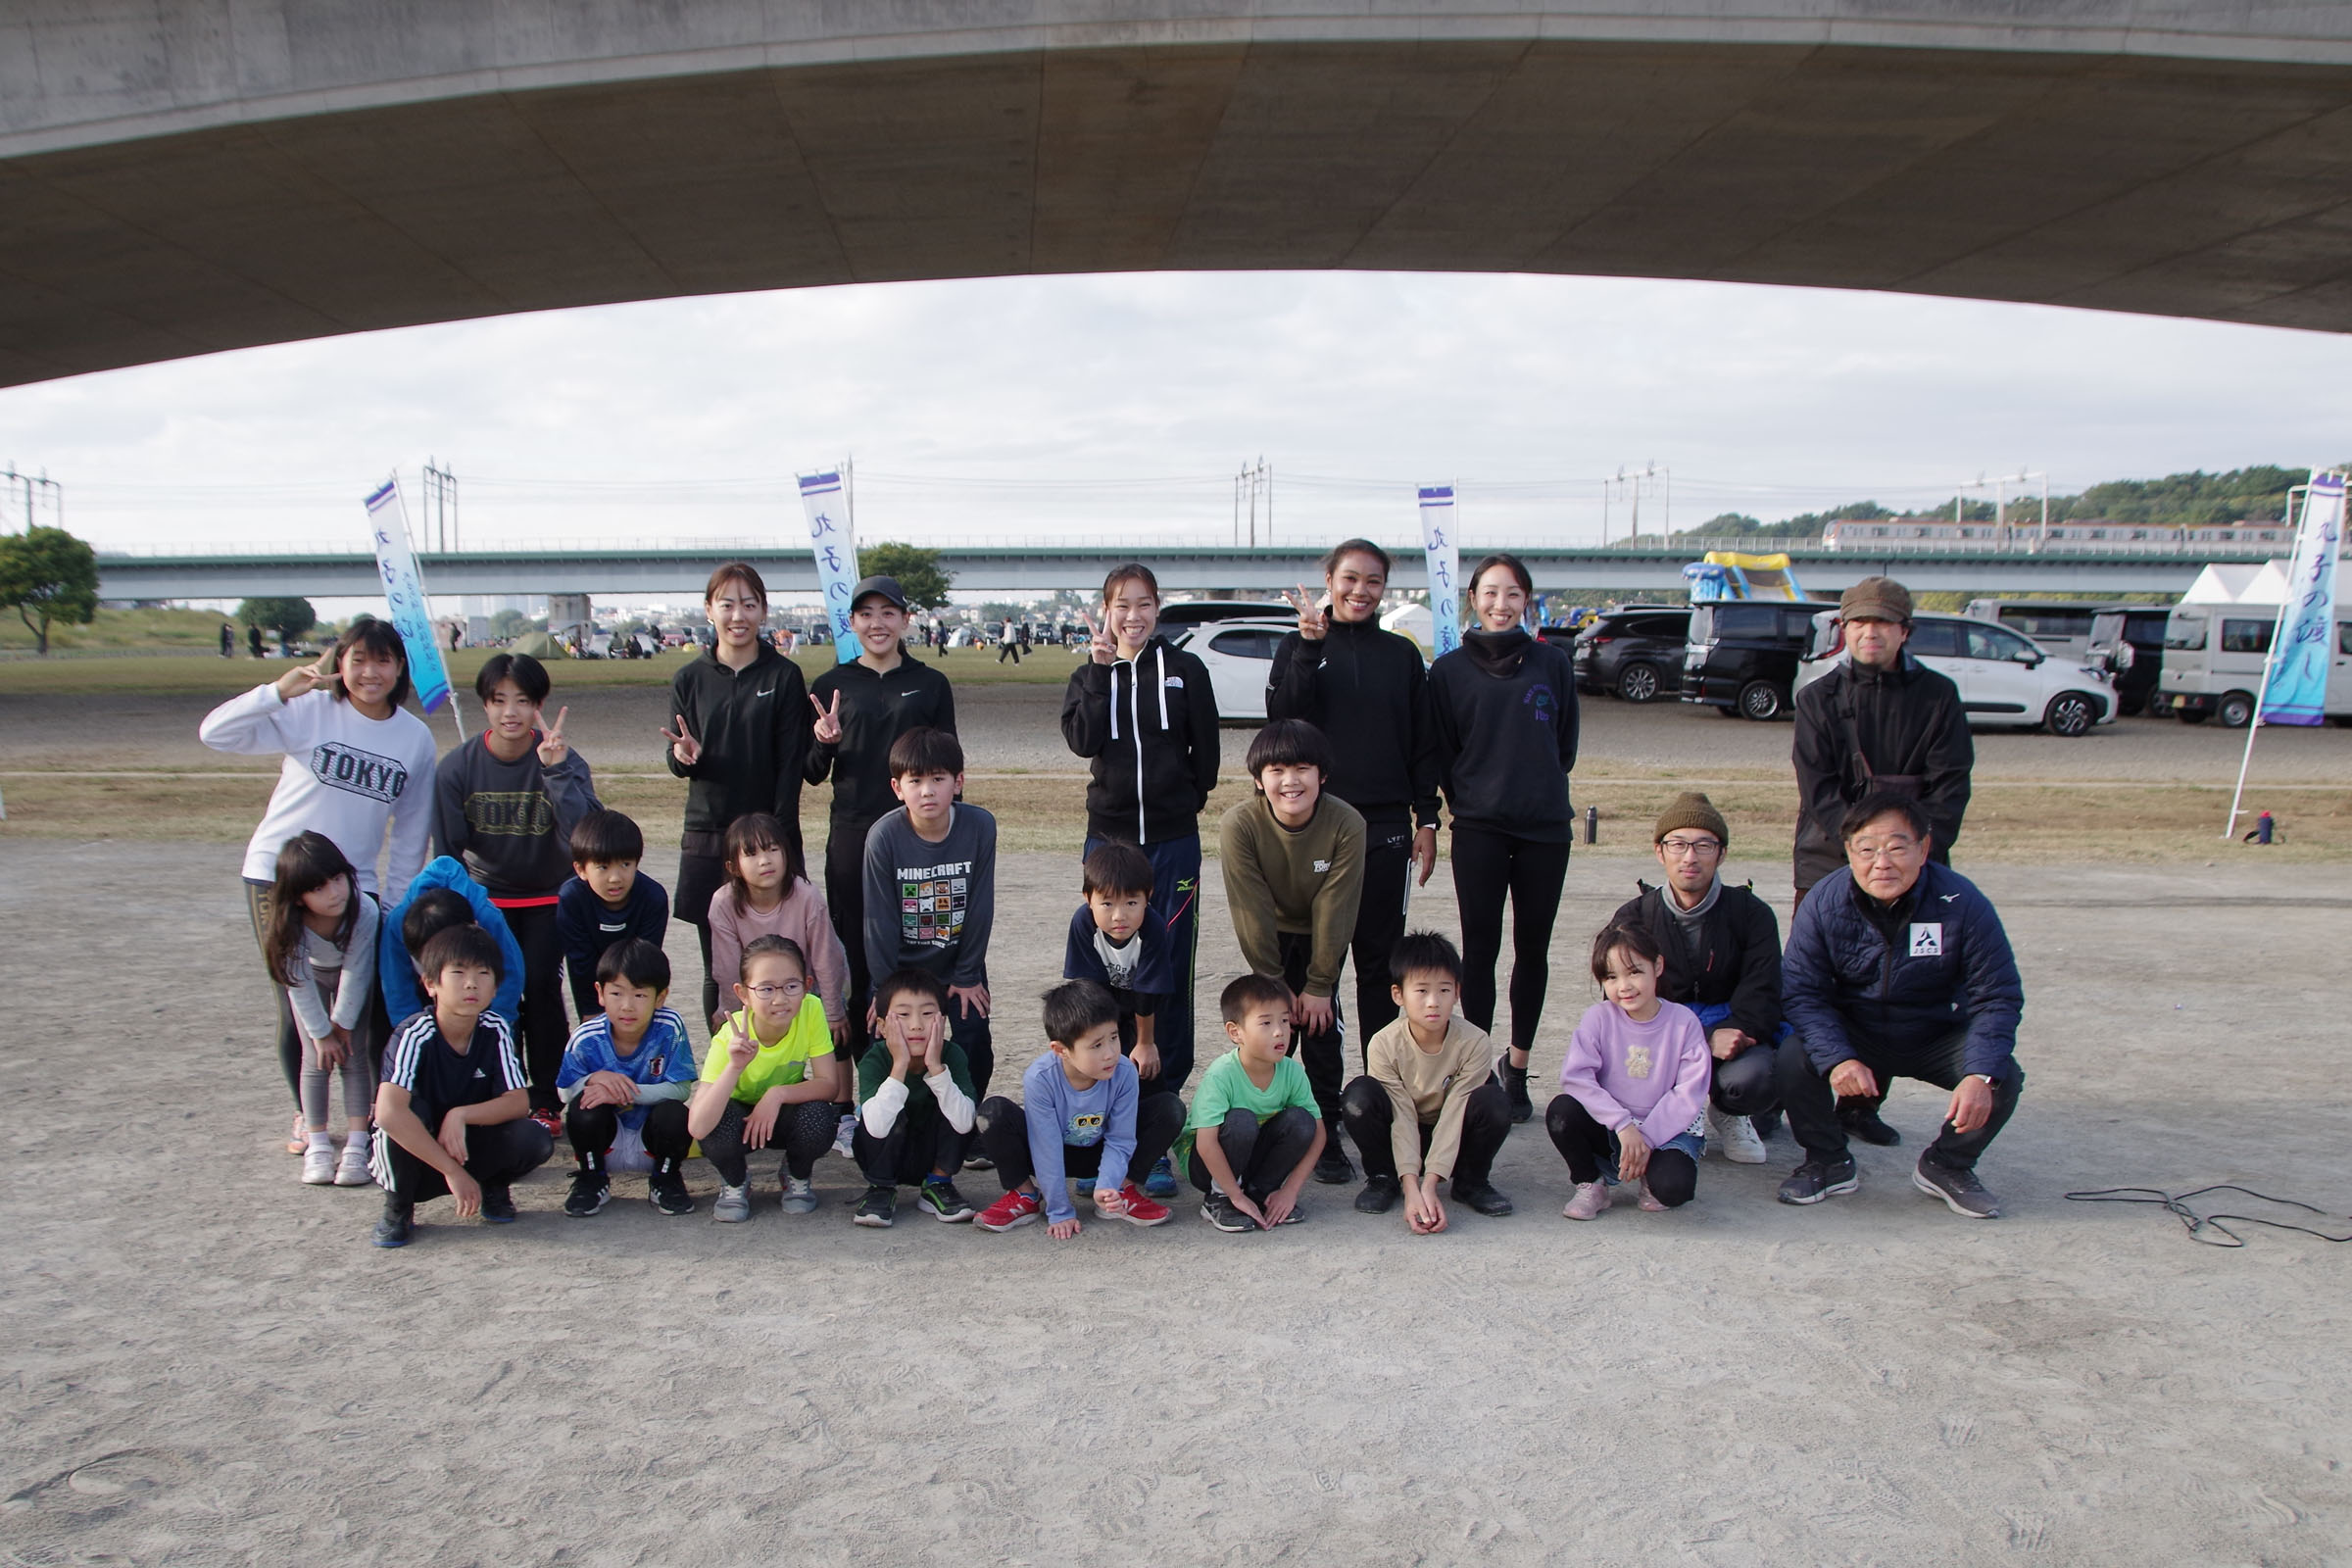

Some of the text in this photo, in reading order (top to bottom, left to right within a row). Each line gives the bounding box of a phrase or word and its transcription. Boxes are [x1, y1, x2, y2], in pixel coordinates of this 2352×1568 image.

[2296, 521, 2338, 681] 丸子の渡し
[320, 747, 408, 798] TOKYO
[897, 861, 971, 880] MINECRAFT
